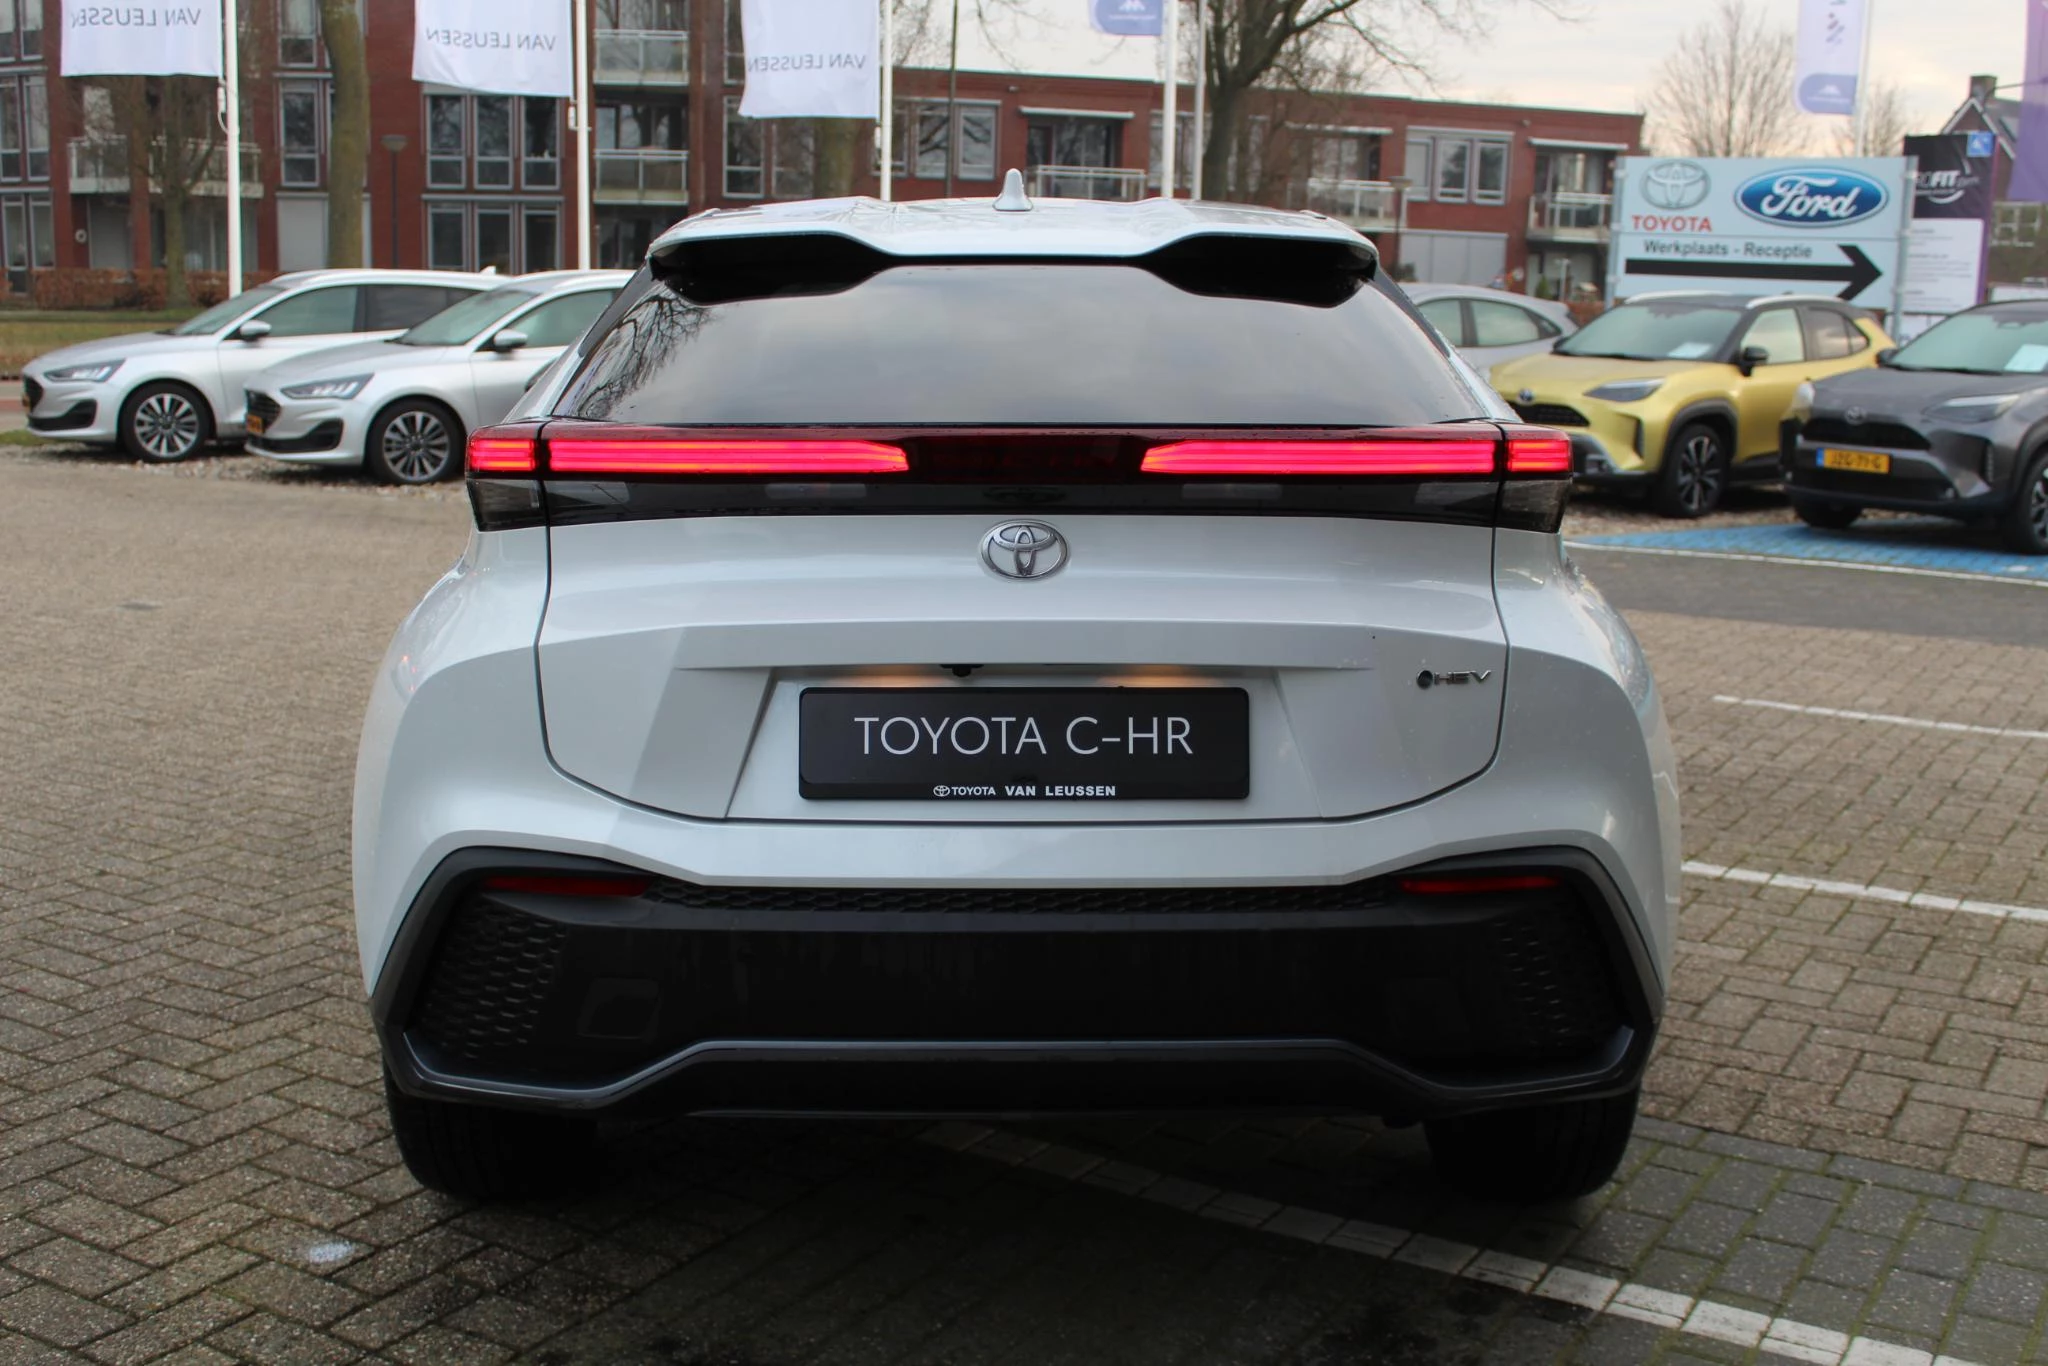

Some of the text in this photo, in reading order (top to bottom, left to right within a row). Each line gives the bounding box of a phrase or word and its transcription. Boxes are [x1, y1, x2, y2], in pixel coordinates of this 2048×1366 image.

[1760, 174, 1860, 218] Ford
[1631, 214, 1713, 232] TOYOTA
[1644, 239, 1729, 257] Werkplaats
[1743, 241, 1812, 261] Receptie
[1434, 669, 1492, 685] HEV
[854, 716, 1194, 755] TOYOTA C-HR
[951, 785, 1116, 797] TOYOTA VAN LEUSSEN
